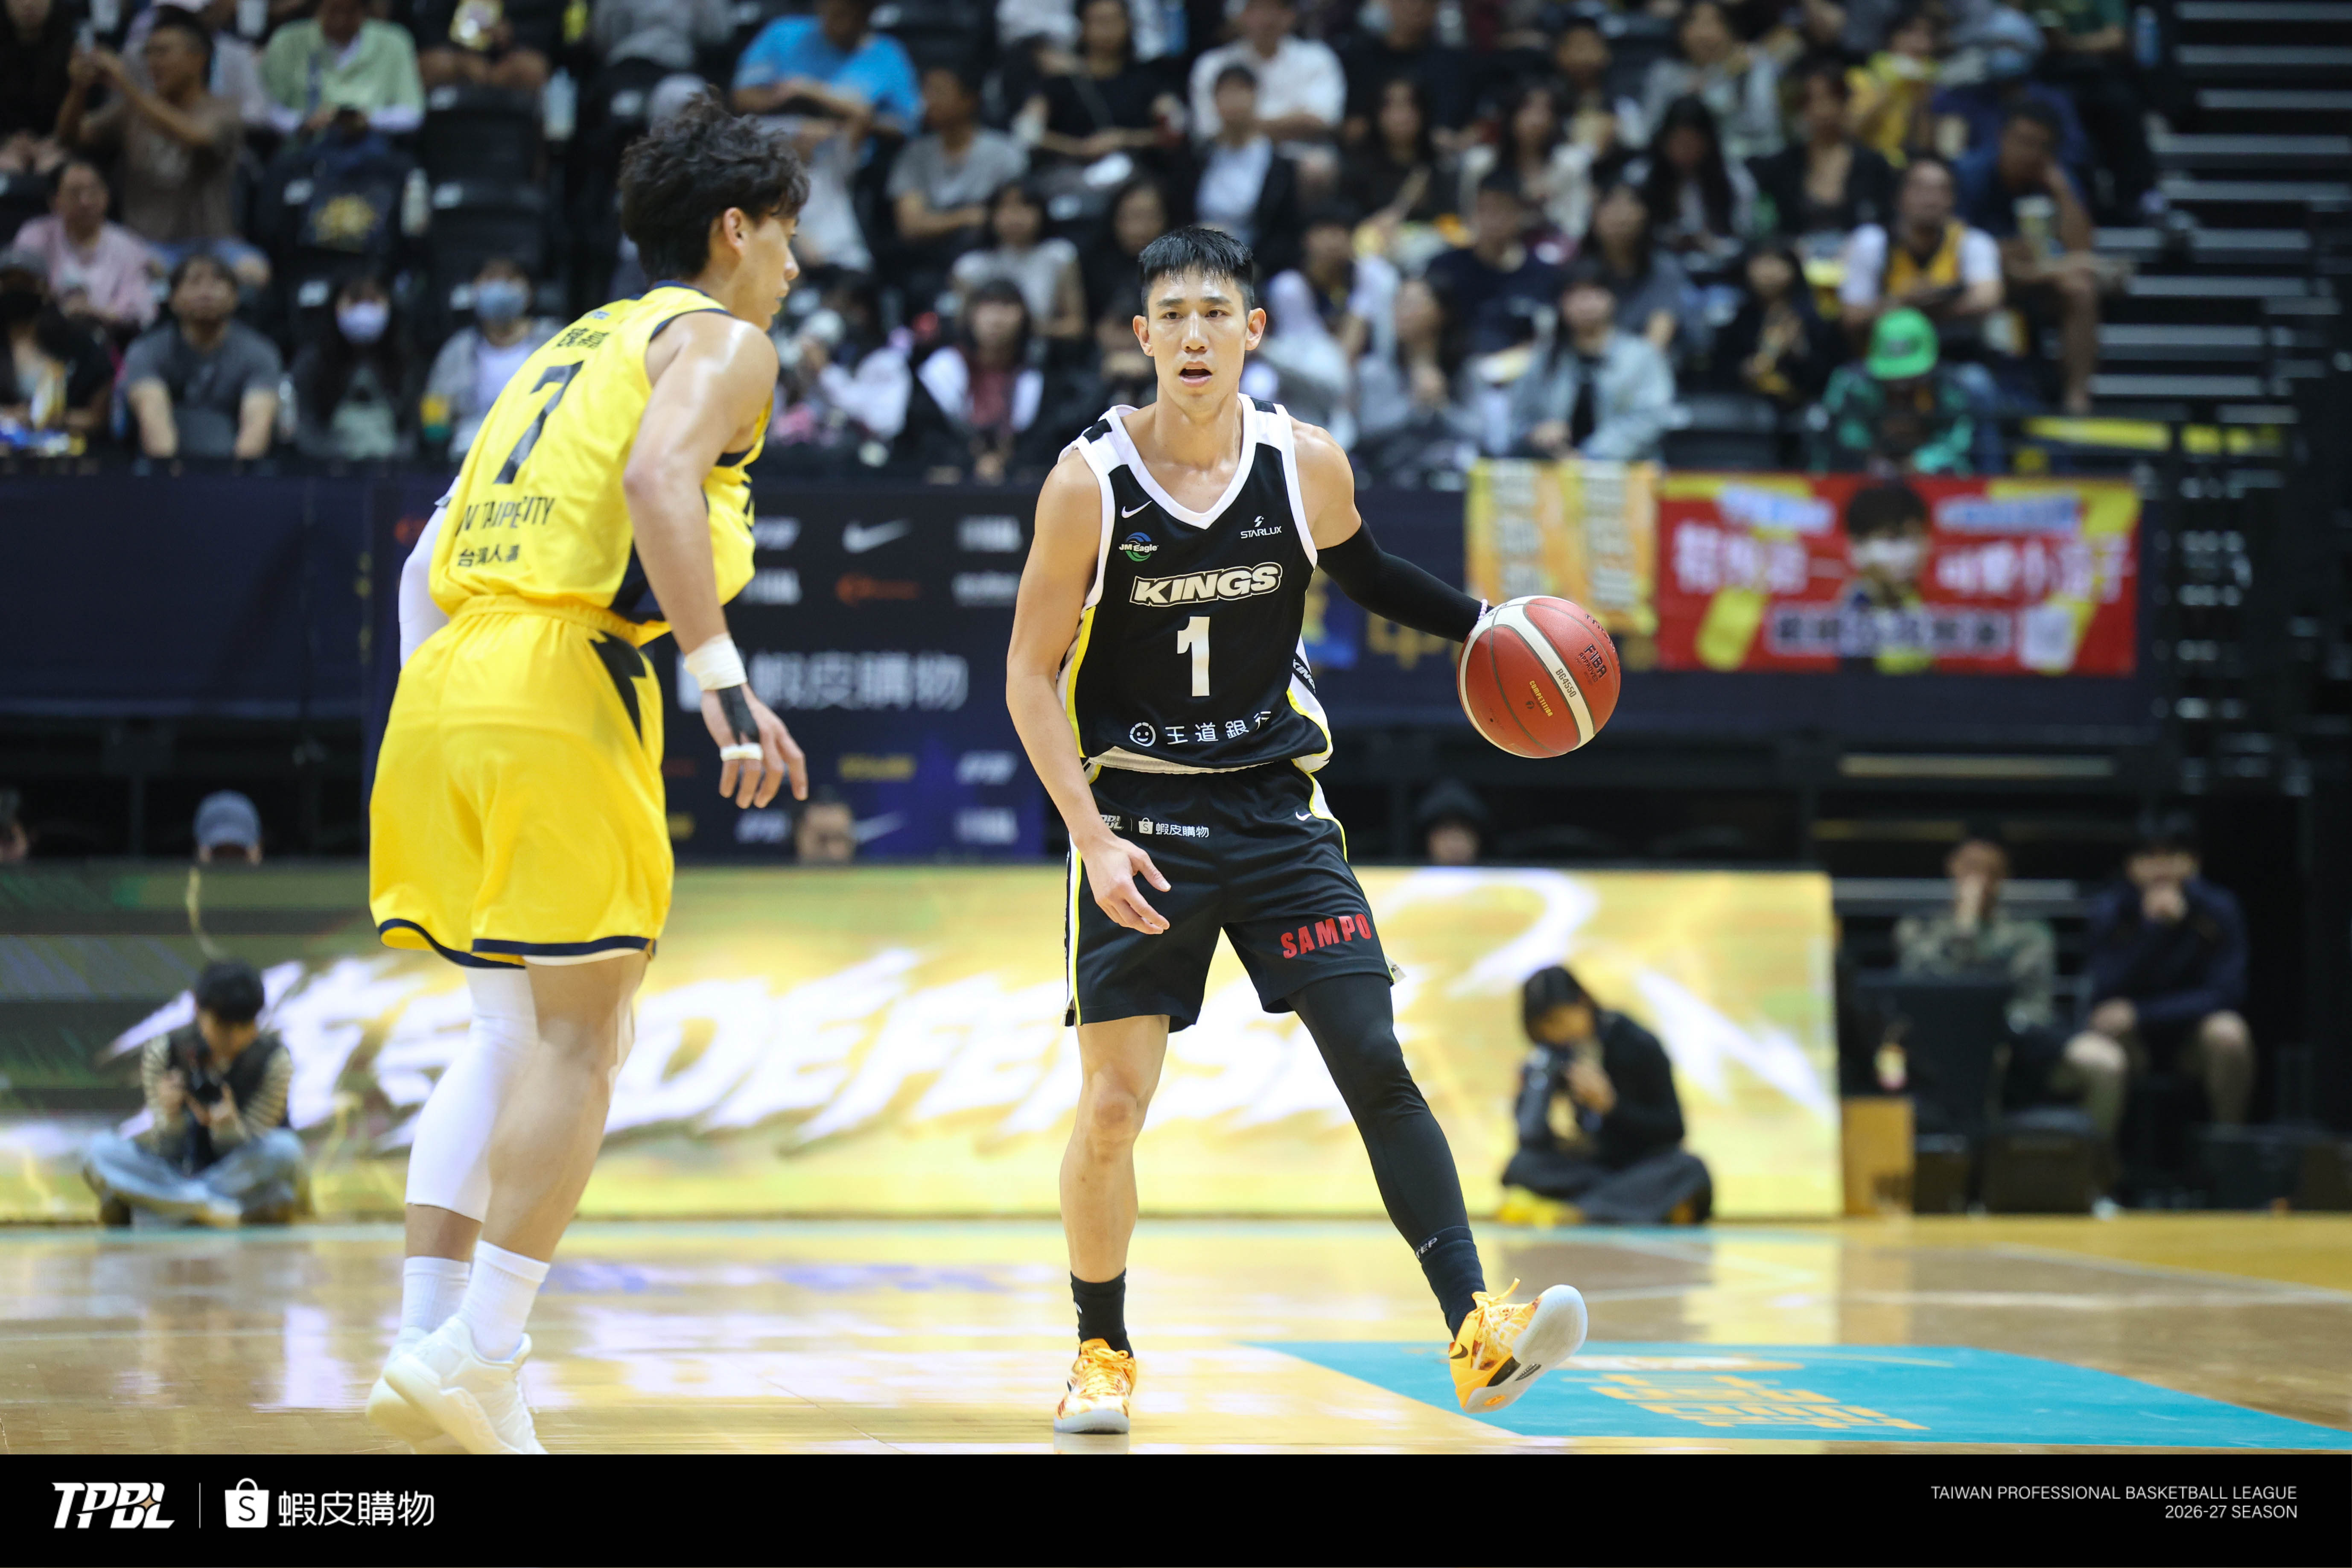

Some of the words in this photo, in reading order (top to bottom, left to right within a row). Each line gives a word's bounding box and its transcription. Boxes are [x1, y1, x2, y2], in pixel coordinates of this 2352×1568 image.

[493, 360, 585, 484] 7
[1133, 543, 1157, 553] Eagle
[1240, 526, 1282, 539] STARLUX
[1130, 562, 1283, 607] KINGS
[1177, 616, 1210, 696] 1
[1579, 652, 1599, 683] APPROVED
[1584, 644, 1607, 678] FIBA
[1293, 658, 1316, 694] KING
[1555, 669, 1577, 698] BG4550
[1529, 680, 1553, 717] COMPETITION
[1156, 822, 1209, 838] 蝦皮購物
[1281, 914, 1372, 959] SAMPO
